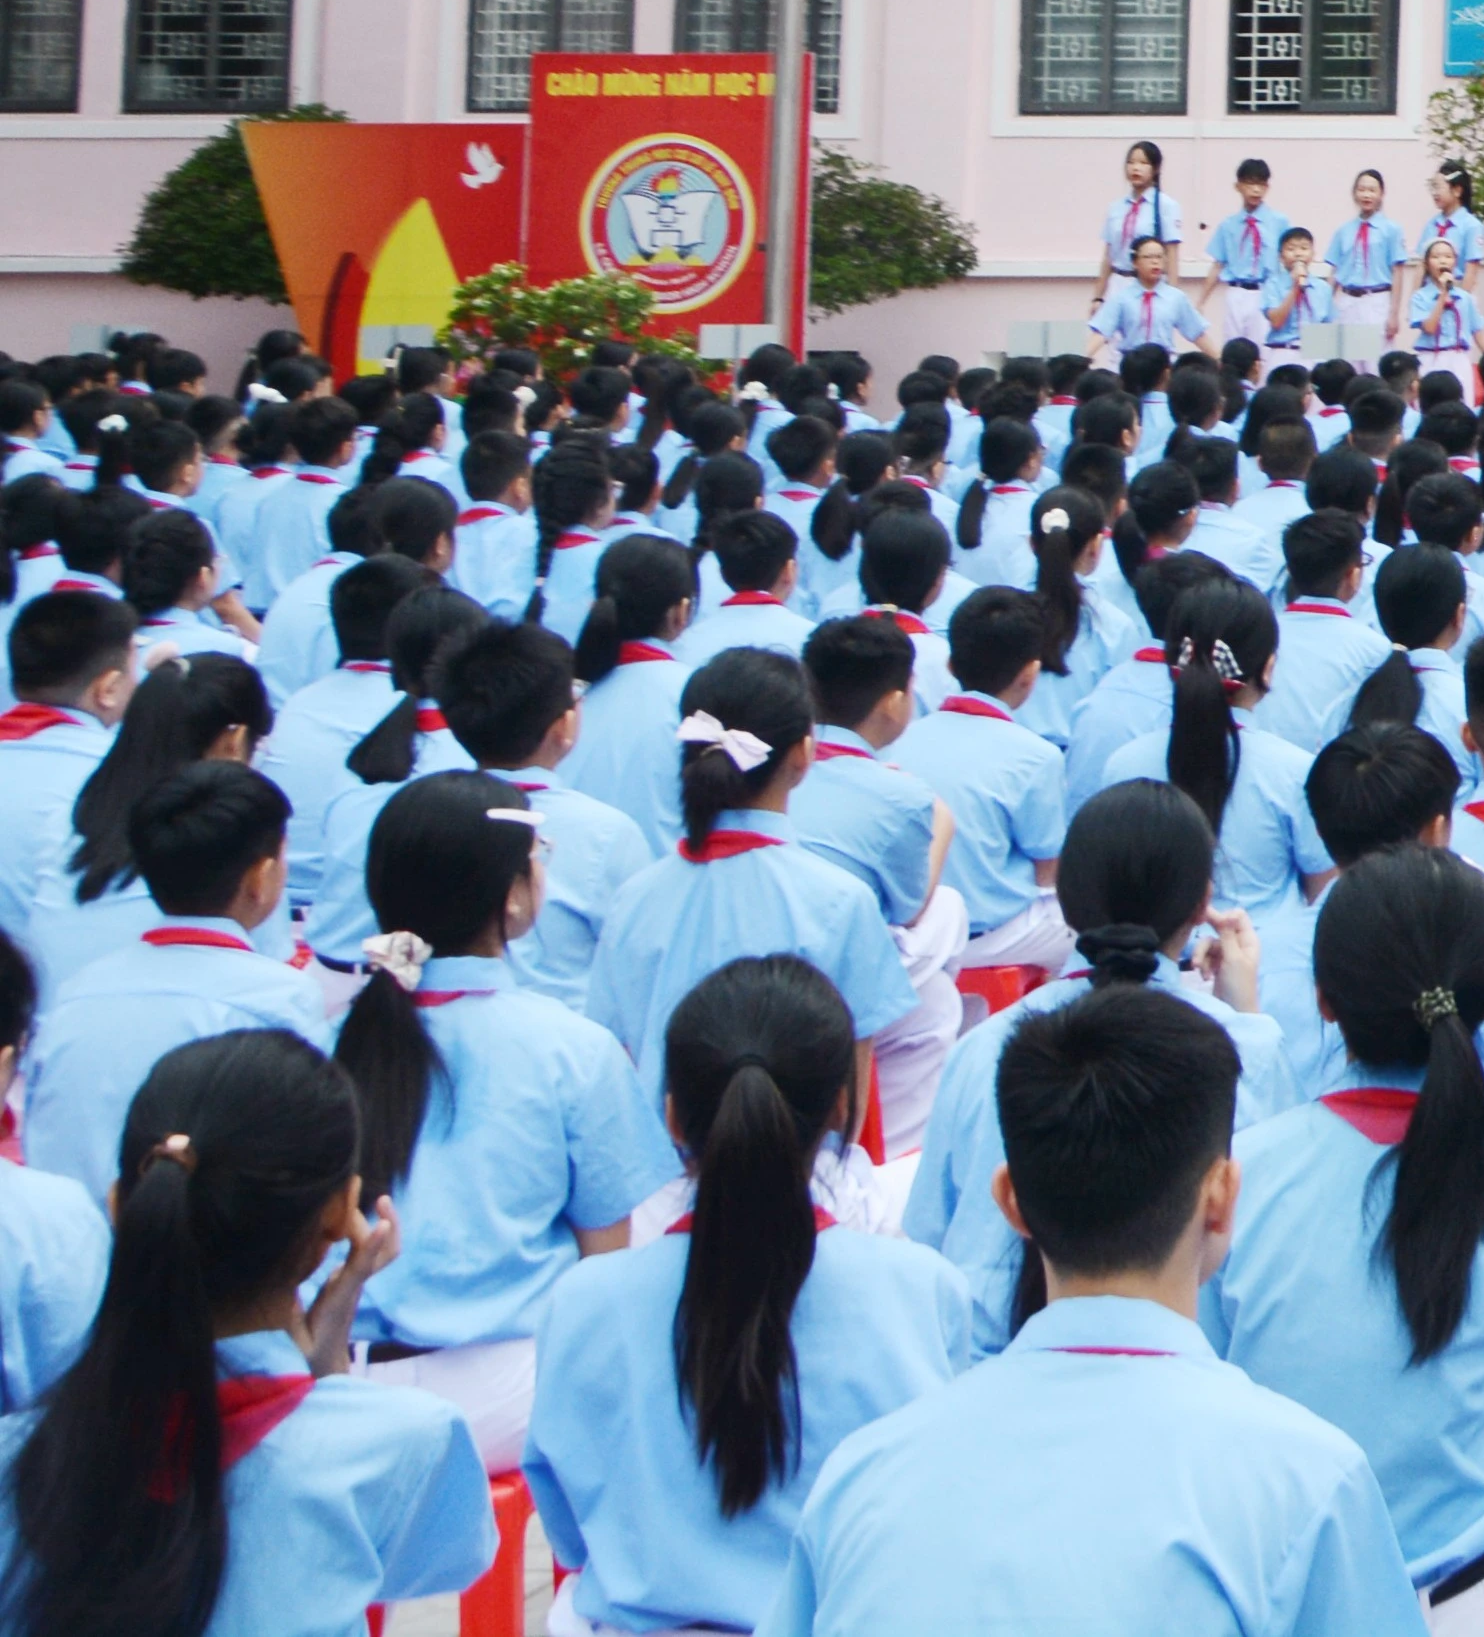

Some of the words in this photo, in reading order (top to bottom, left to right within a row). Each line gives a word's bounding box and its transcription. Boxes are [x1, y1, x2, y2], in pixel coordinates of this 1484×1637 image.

[546, 68, 598, 96] CHÀO
[602, 68, 661, 96] MỪNG
[664, 68, 711, 96] NĂM
[714, 73, 753, 101] HỌC
